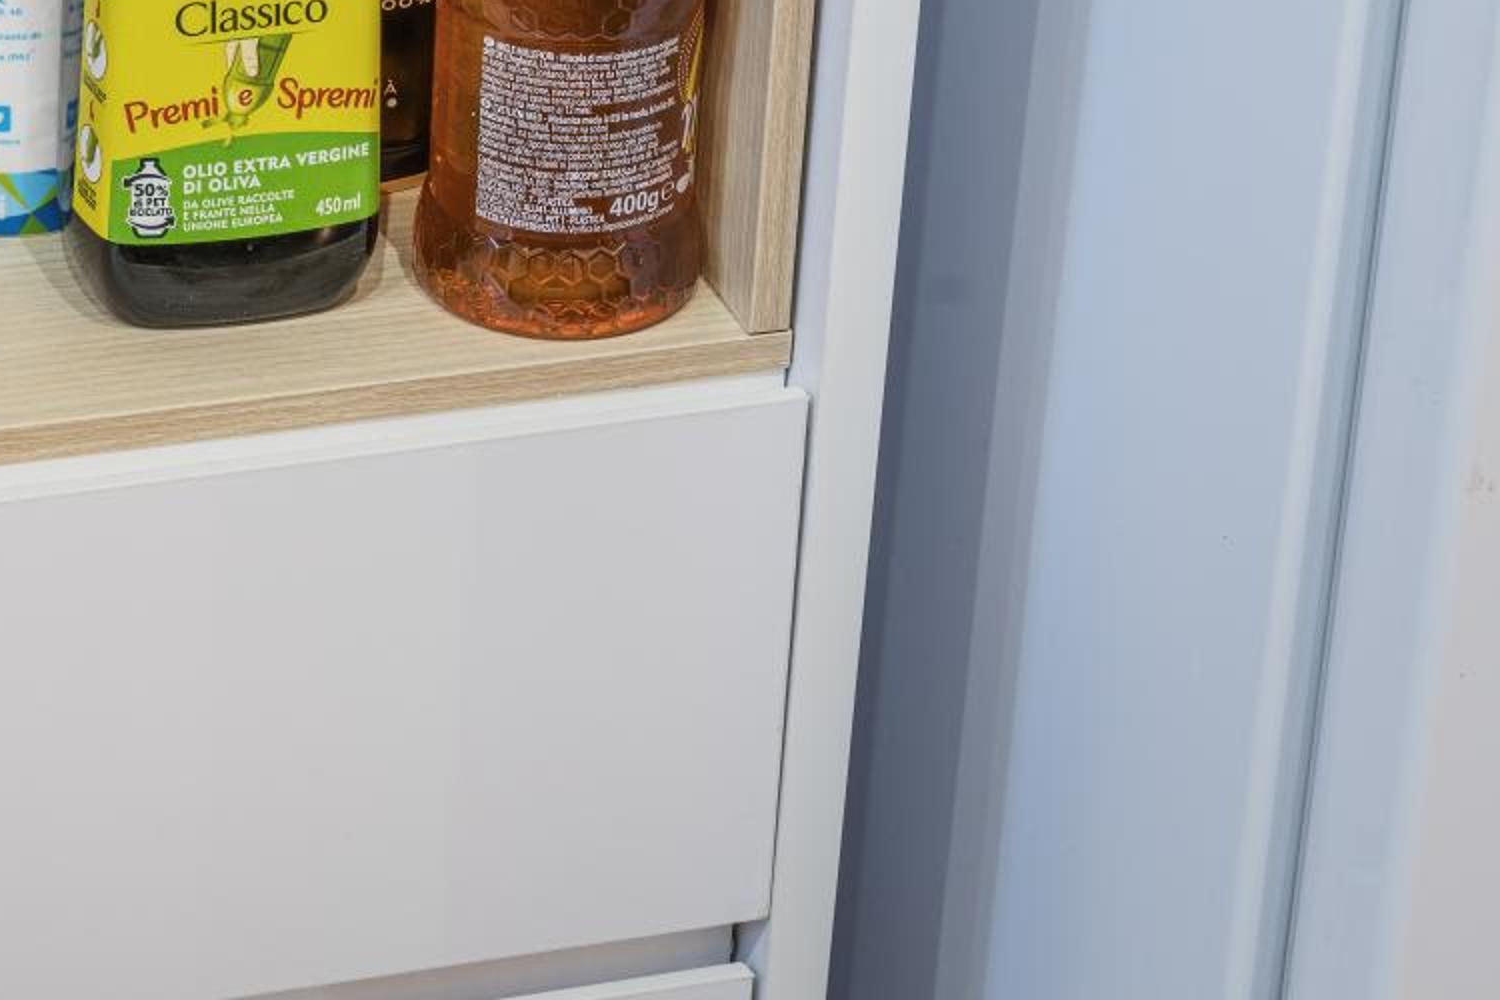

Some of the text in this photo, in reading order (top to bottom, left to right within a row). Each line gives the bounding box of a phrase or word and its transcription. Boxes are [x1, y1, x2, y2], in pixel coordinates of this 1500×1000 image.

[124, 86, 219, 134] Premi
[238, 89, 253, 107] e
[276, 77, 379, 120] Spremi
[183, 142, 370, 179] OLIO EXTRA VERGINE
[134, 183, 169, 198] 50%
[183, 175, 262, 195] DI OLIVA
[146, 197, 167, 208] PET
[183, 189, 295, 210] DA OLIVE RACCOLTE
[610, 191, 659, 218] 400g
[183, 203, 275, 221] E FRANTE NELLA
[183, 214, 284, 233] UNIONE EUROPEA
